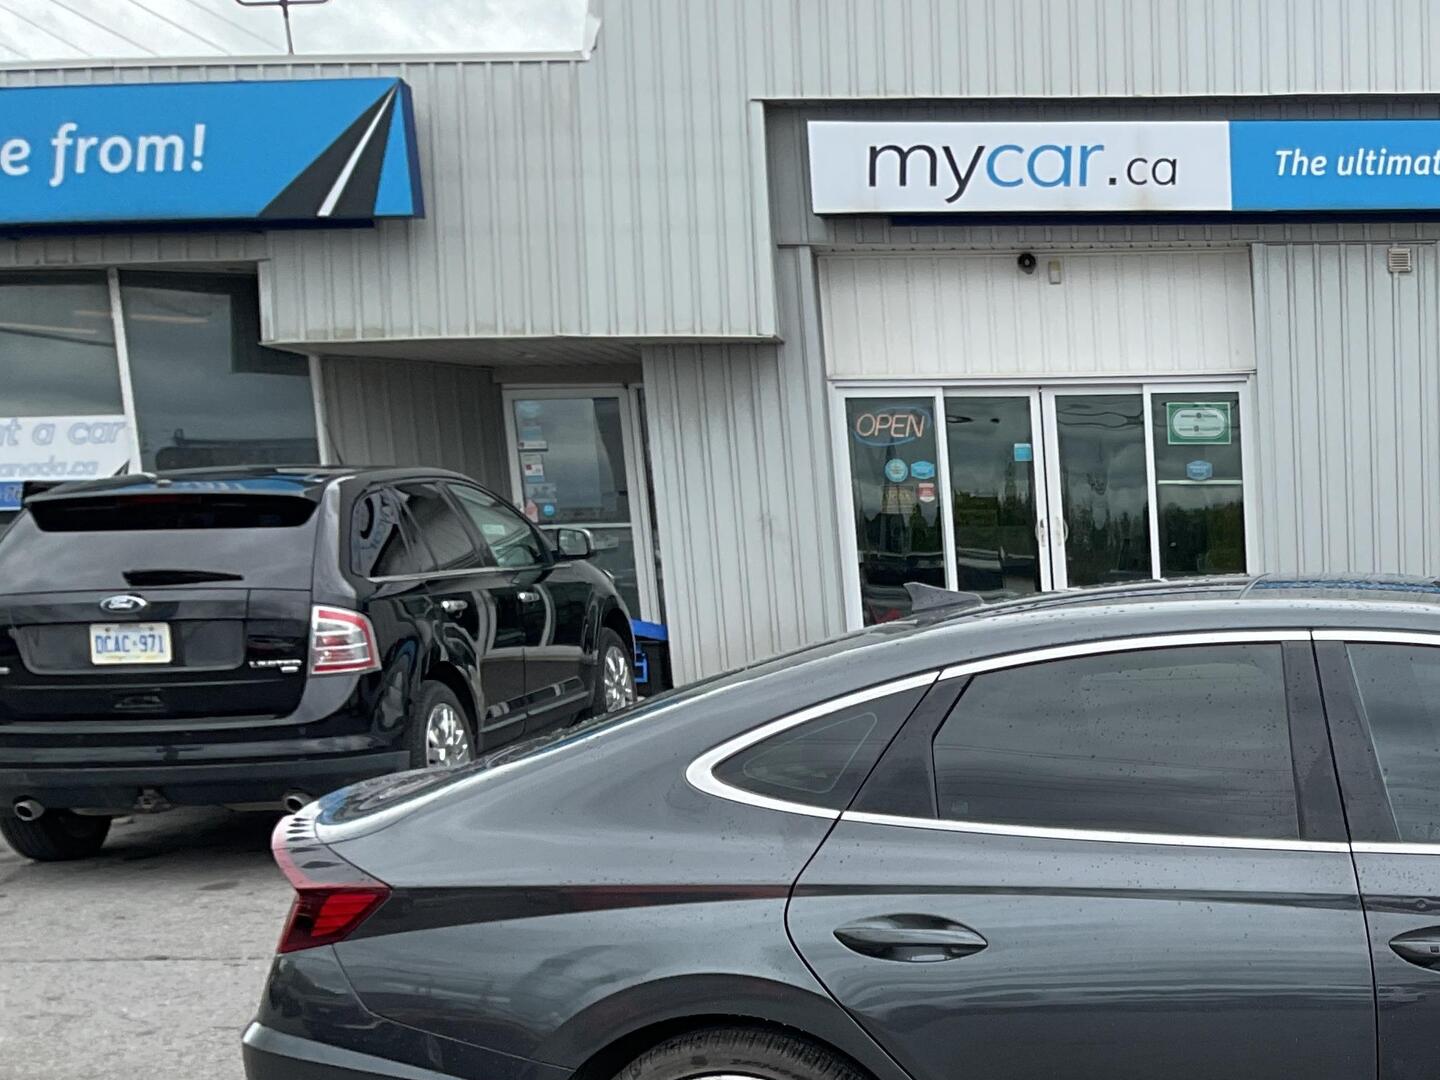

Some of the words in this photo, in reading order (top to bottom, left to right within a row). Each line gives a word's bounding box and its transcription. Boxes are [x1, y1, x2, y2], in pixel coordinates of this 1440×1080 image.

[49, 122, 206, 187] from!
[1275, 148, 1328, 176] The
[868, 143, 1178, 204] mycar.ca
[32, 422, 56, 446] a
[67, 422, 127, 446] car
[856, 413, 925, 438] OPEN
